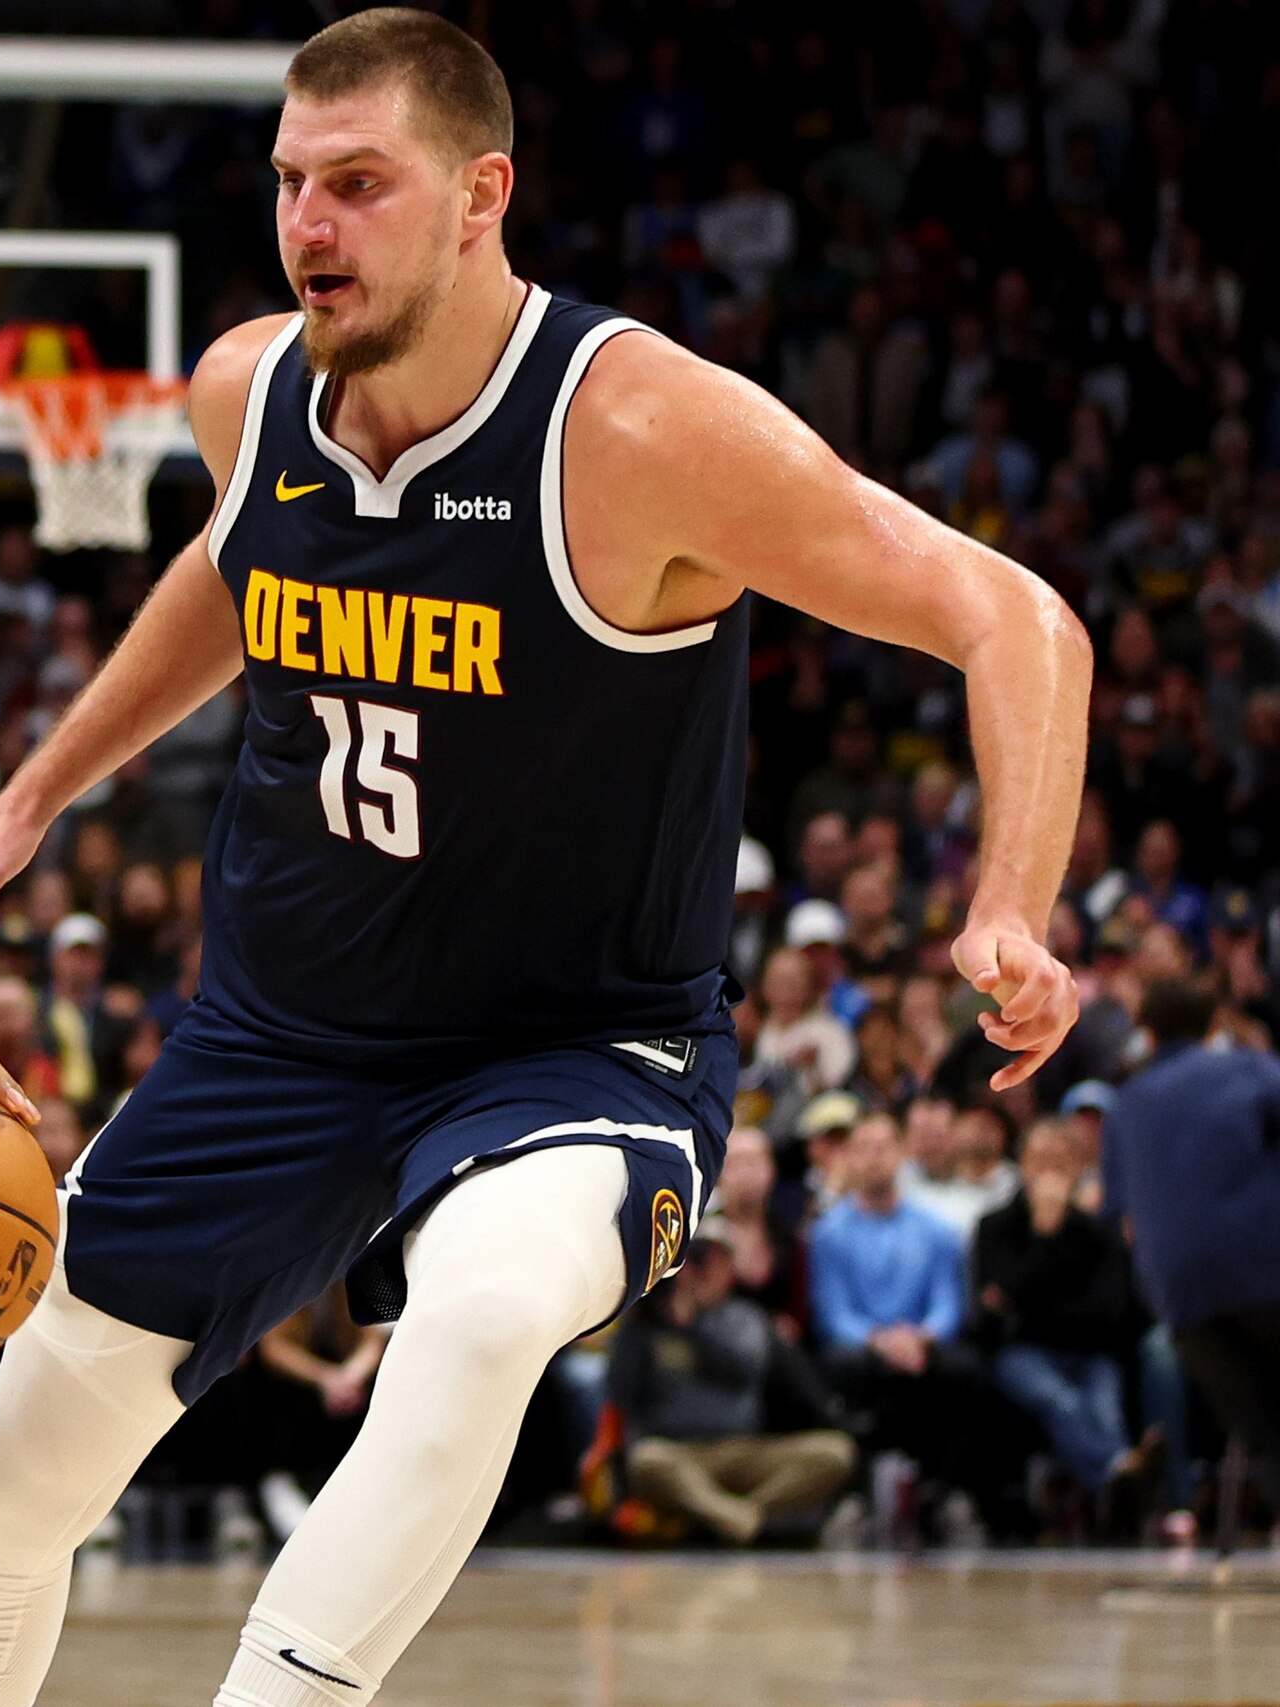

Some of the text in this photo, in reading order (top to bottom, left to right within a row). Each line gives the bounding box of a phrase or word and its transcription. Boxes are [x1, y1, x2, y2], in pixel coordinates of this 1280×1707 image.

[433, 491, 512, 523] ibotta
[243, 567, 506, 697] DENVER
[309, 694, 423, 860] 15
